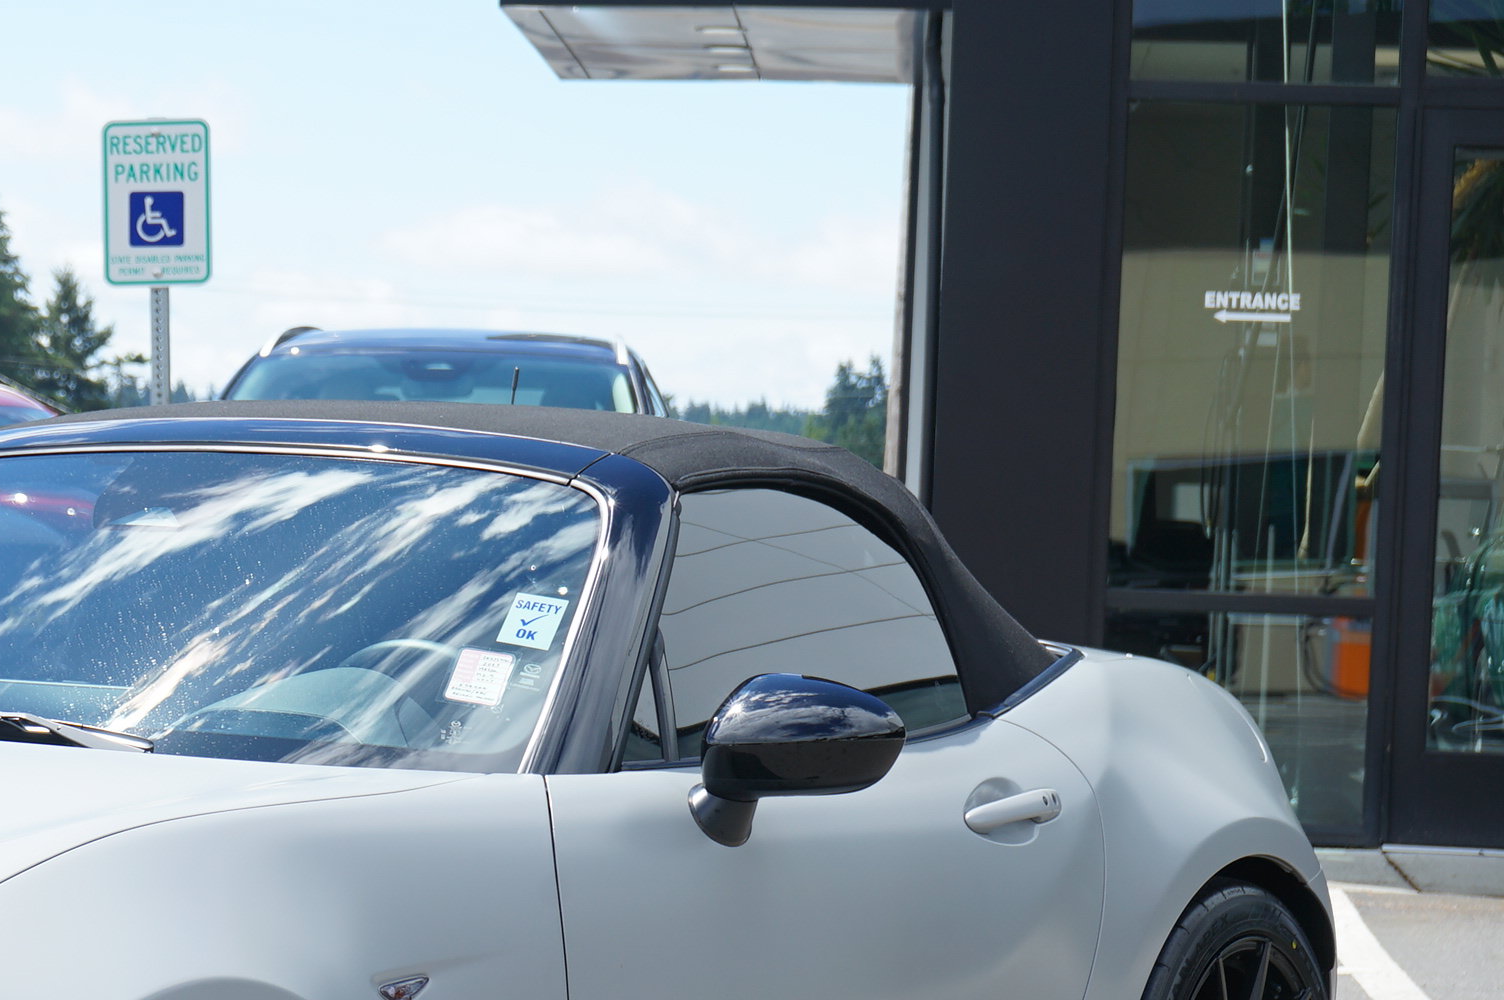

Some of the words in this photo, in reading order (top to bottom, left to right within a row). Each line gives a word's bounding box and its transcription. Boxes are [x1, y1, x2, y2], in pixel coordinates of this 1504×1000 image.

[109, 133, 203, 156] RESERVED
[114, 162, 199, 183] PARKING
[1204, 290, 1301, 311] ENTRANCE
[515, 599, 562, 615] SAFETY
[515, 628, 538, 641] OK
